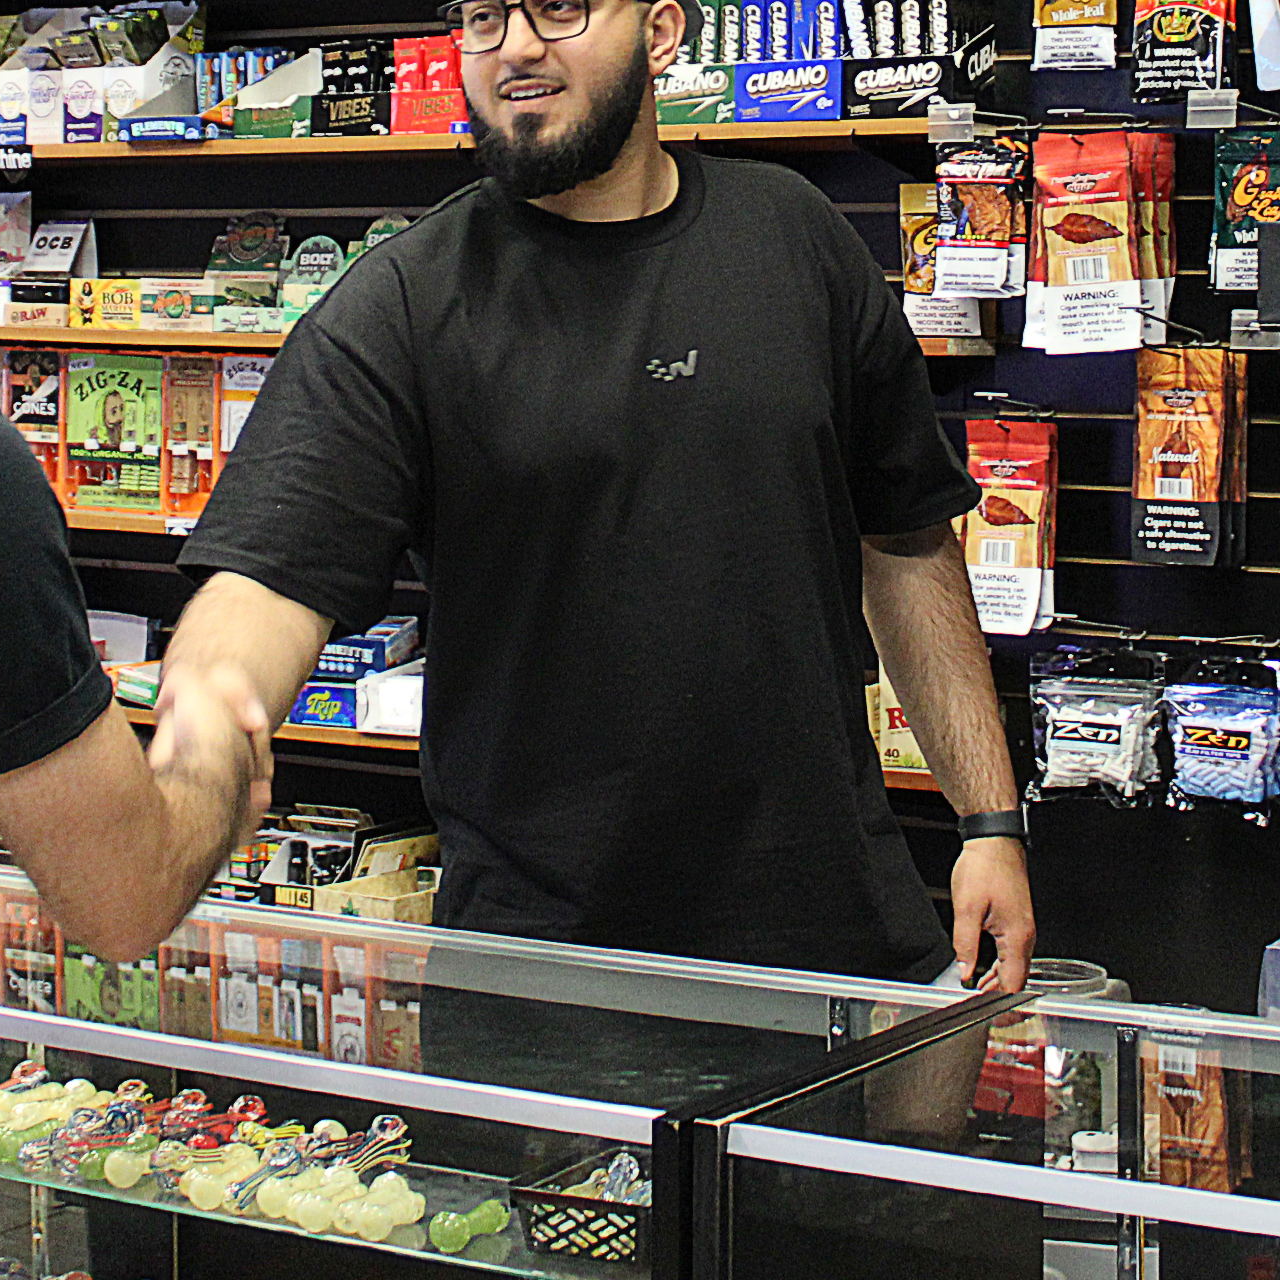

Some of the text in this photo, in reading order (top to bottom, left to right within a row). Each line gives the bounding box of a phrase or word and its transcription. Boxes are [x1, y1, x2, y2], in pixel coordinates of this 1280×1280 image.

[1051, 2, 1106, 22] Whole-leaf
[746, 65, 828, 95] CUBANO
[855, 62, 942, 95] CUBANO
[329, 97, 371, 121] VIBES
[412, 95, 453, 117] VIBES
[132, 120, 186, 136] ELEMENTS
[35, 236, 73, 250] OCB
[300, 252, 335, 265] BOLT
[102, 292, 134, 305] BOB
[1063, 290, 1119, 302] WARNING:
[20, 307, 48, 321] RAW
[13, 401, 56, 417] CONES
[70, 449, 131, 460] 100% ORGANIC
[1148, 446, 1200, 464] Natural
[1147, 505, 1200, 517] WARNING:
[1145, 518, 1172, 530] Cigars
[974, 573, 1020, 584] WARNING:
[884, 748, 900, 758] 40
